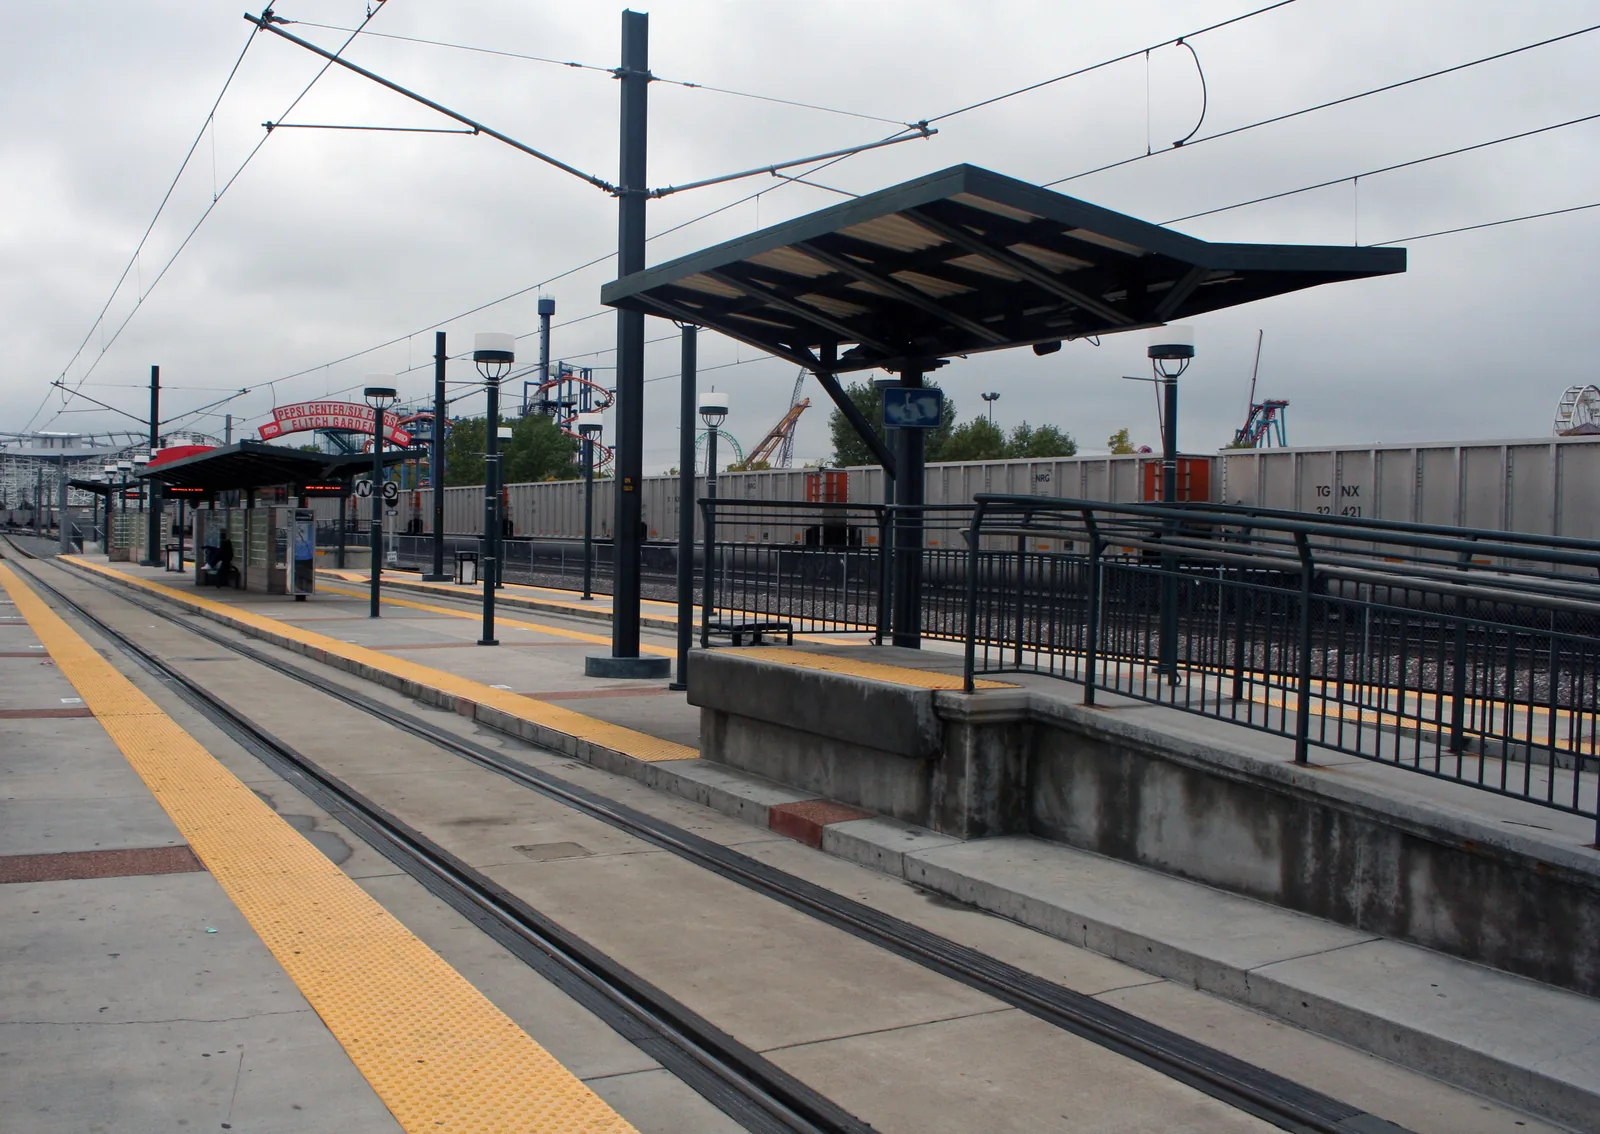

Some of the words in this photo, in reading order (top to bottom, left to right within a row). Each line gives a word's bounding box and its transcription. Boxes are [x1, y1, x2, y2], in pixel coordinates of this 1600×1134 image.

[278, 407, 305, 421] PEPSI
[366, 409, 396, 428] FLGS
[291, 416, 329, 430] ELITCH
[333, 418, 376, 433] GARDEN
[1035, 474, 1050, 483] NRG
[357, 482, 371, 496] N
[384, 483, 396, 497] S
[1316, 485, 1331, 498] TG
[1341, 485, 1360, 498] NX
[1341, 506, 1361, 518] 421
